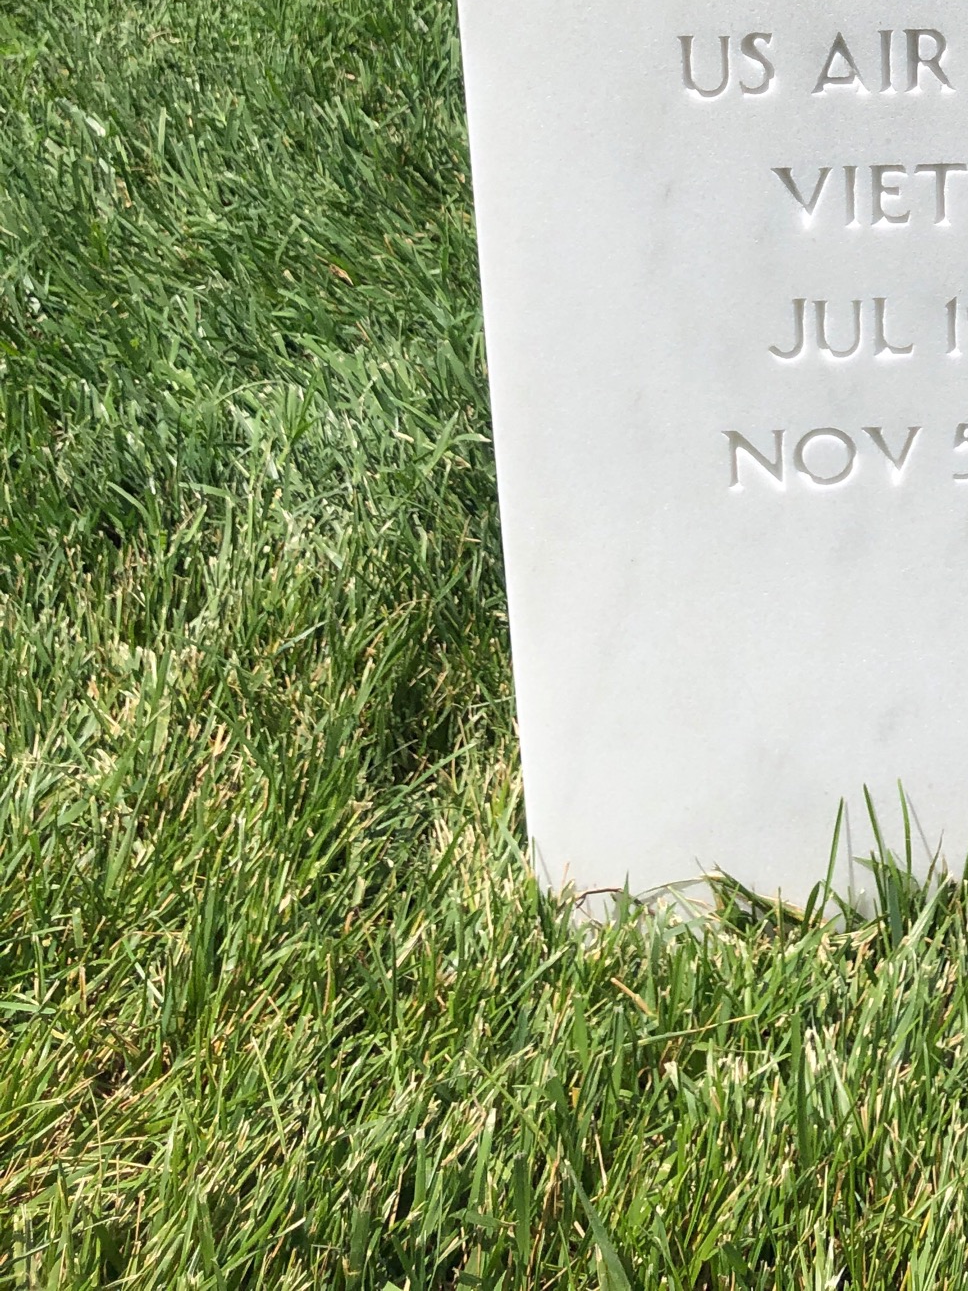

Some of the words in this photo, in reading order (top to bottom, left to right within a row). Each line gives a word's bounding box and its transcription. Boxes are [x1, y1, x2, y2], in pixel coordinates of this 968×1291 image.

[677, 32, 776, 98] US
[812, 27, 956, 95] AIR
[769, 297, 914, 360] JUL
[722, 424, 922, 489] NOV
